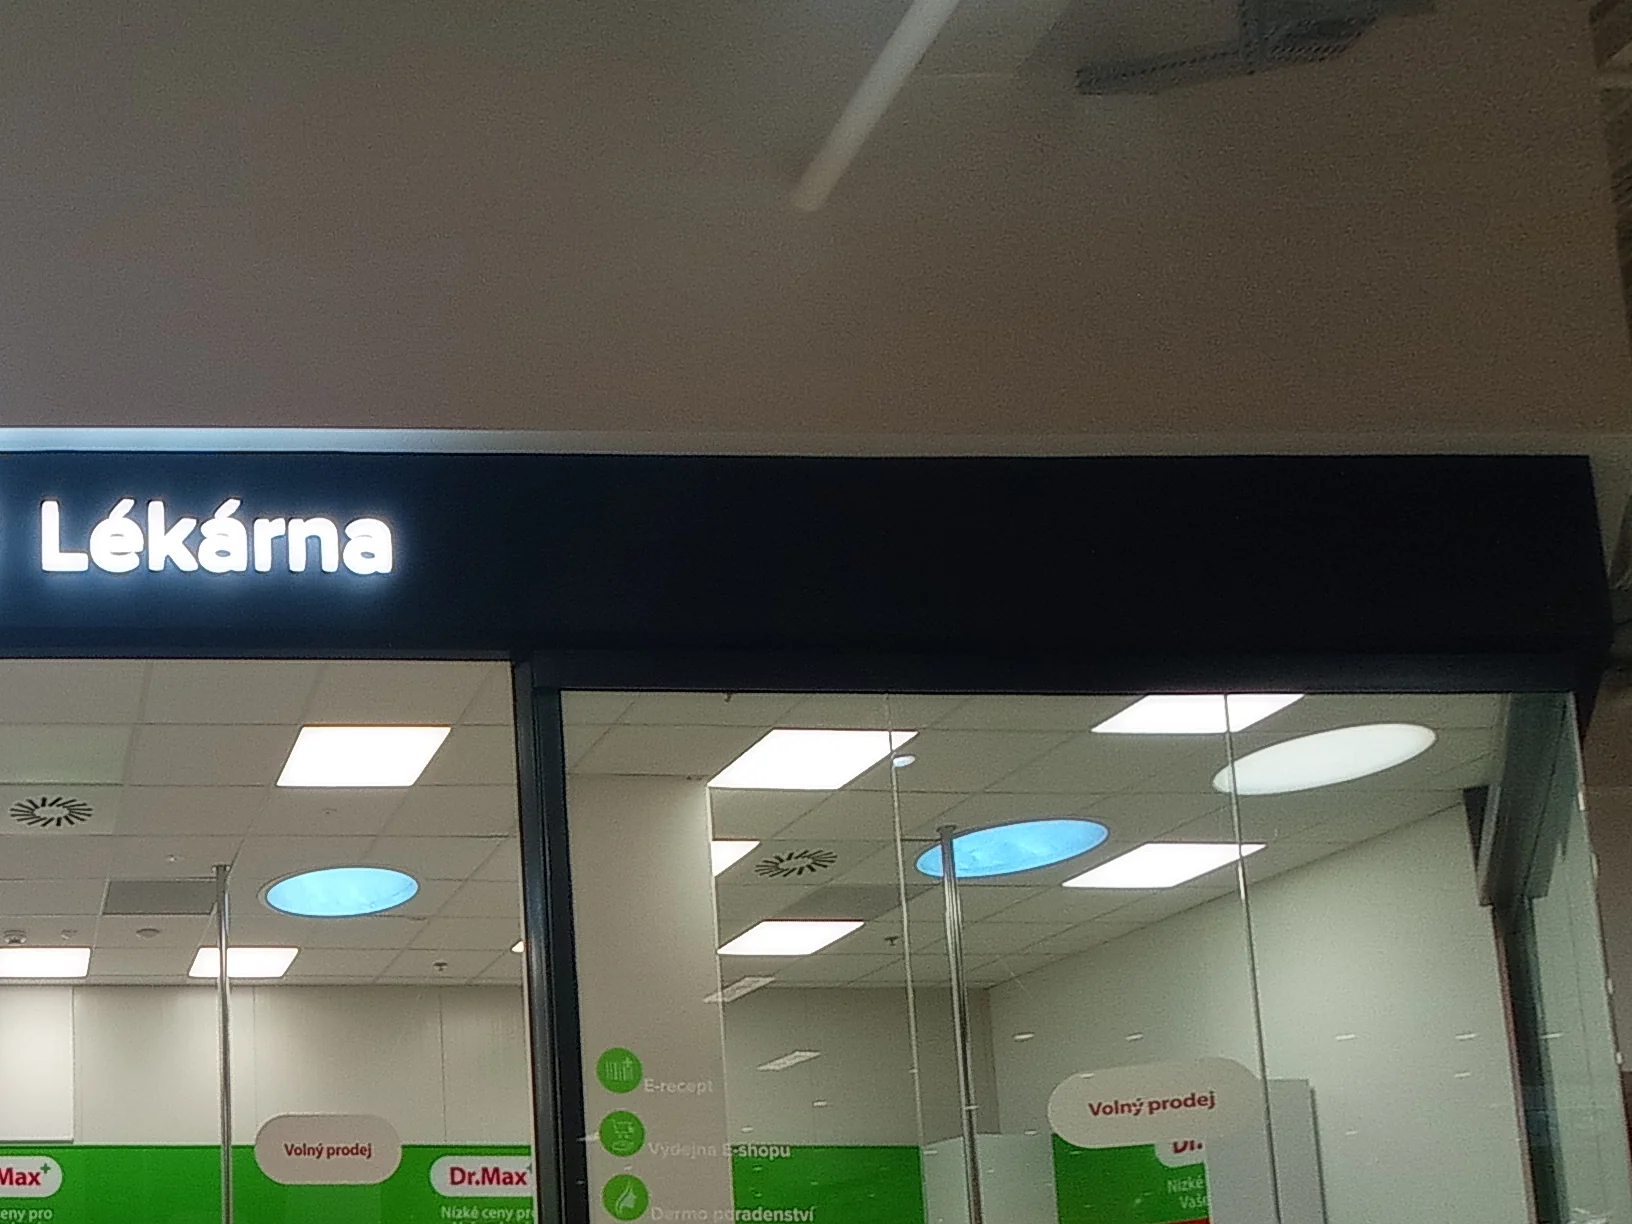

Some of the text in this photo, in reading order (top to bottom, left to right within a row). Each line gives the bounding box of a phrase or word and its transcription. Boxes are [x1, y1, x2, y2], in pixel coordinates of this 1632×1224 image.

[40, 498, 395, 575] Lékárna
[643, 1079, 713, 1096] E-recept
[1088, 1089, 1217, 1118] Volný prodej
[283, 1141, 373, 1160] Volný prodej
[28, 1209, 53, 1223] pro
[441, 1205, 480, 1219] Nízké
[481, 1208, 514, 1222] ceny
[713, 1205, 817, 1224] poradenství
